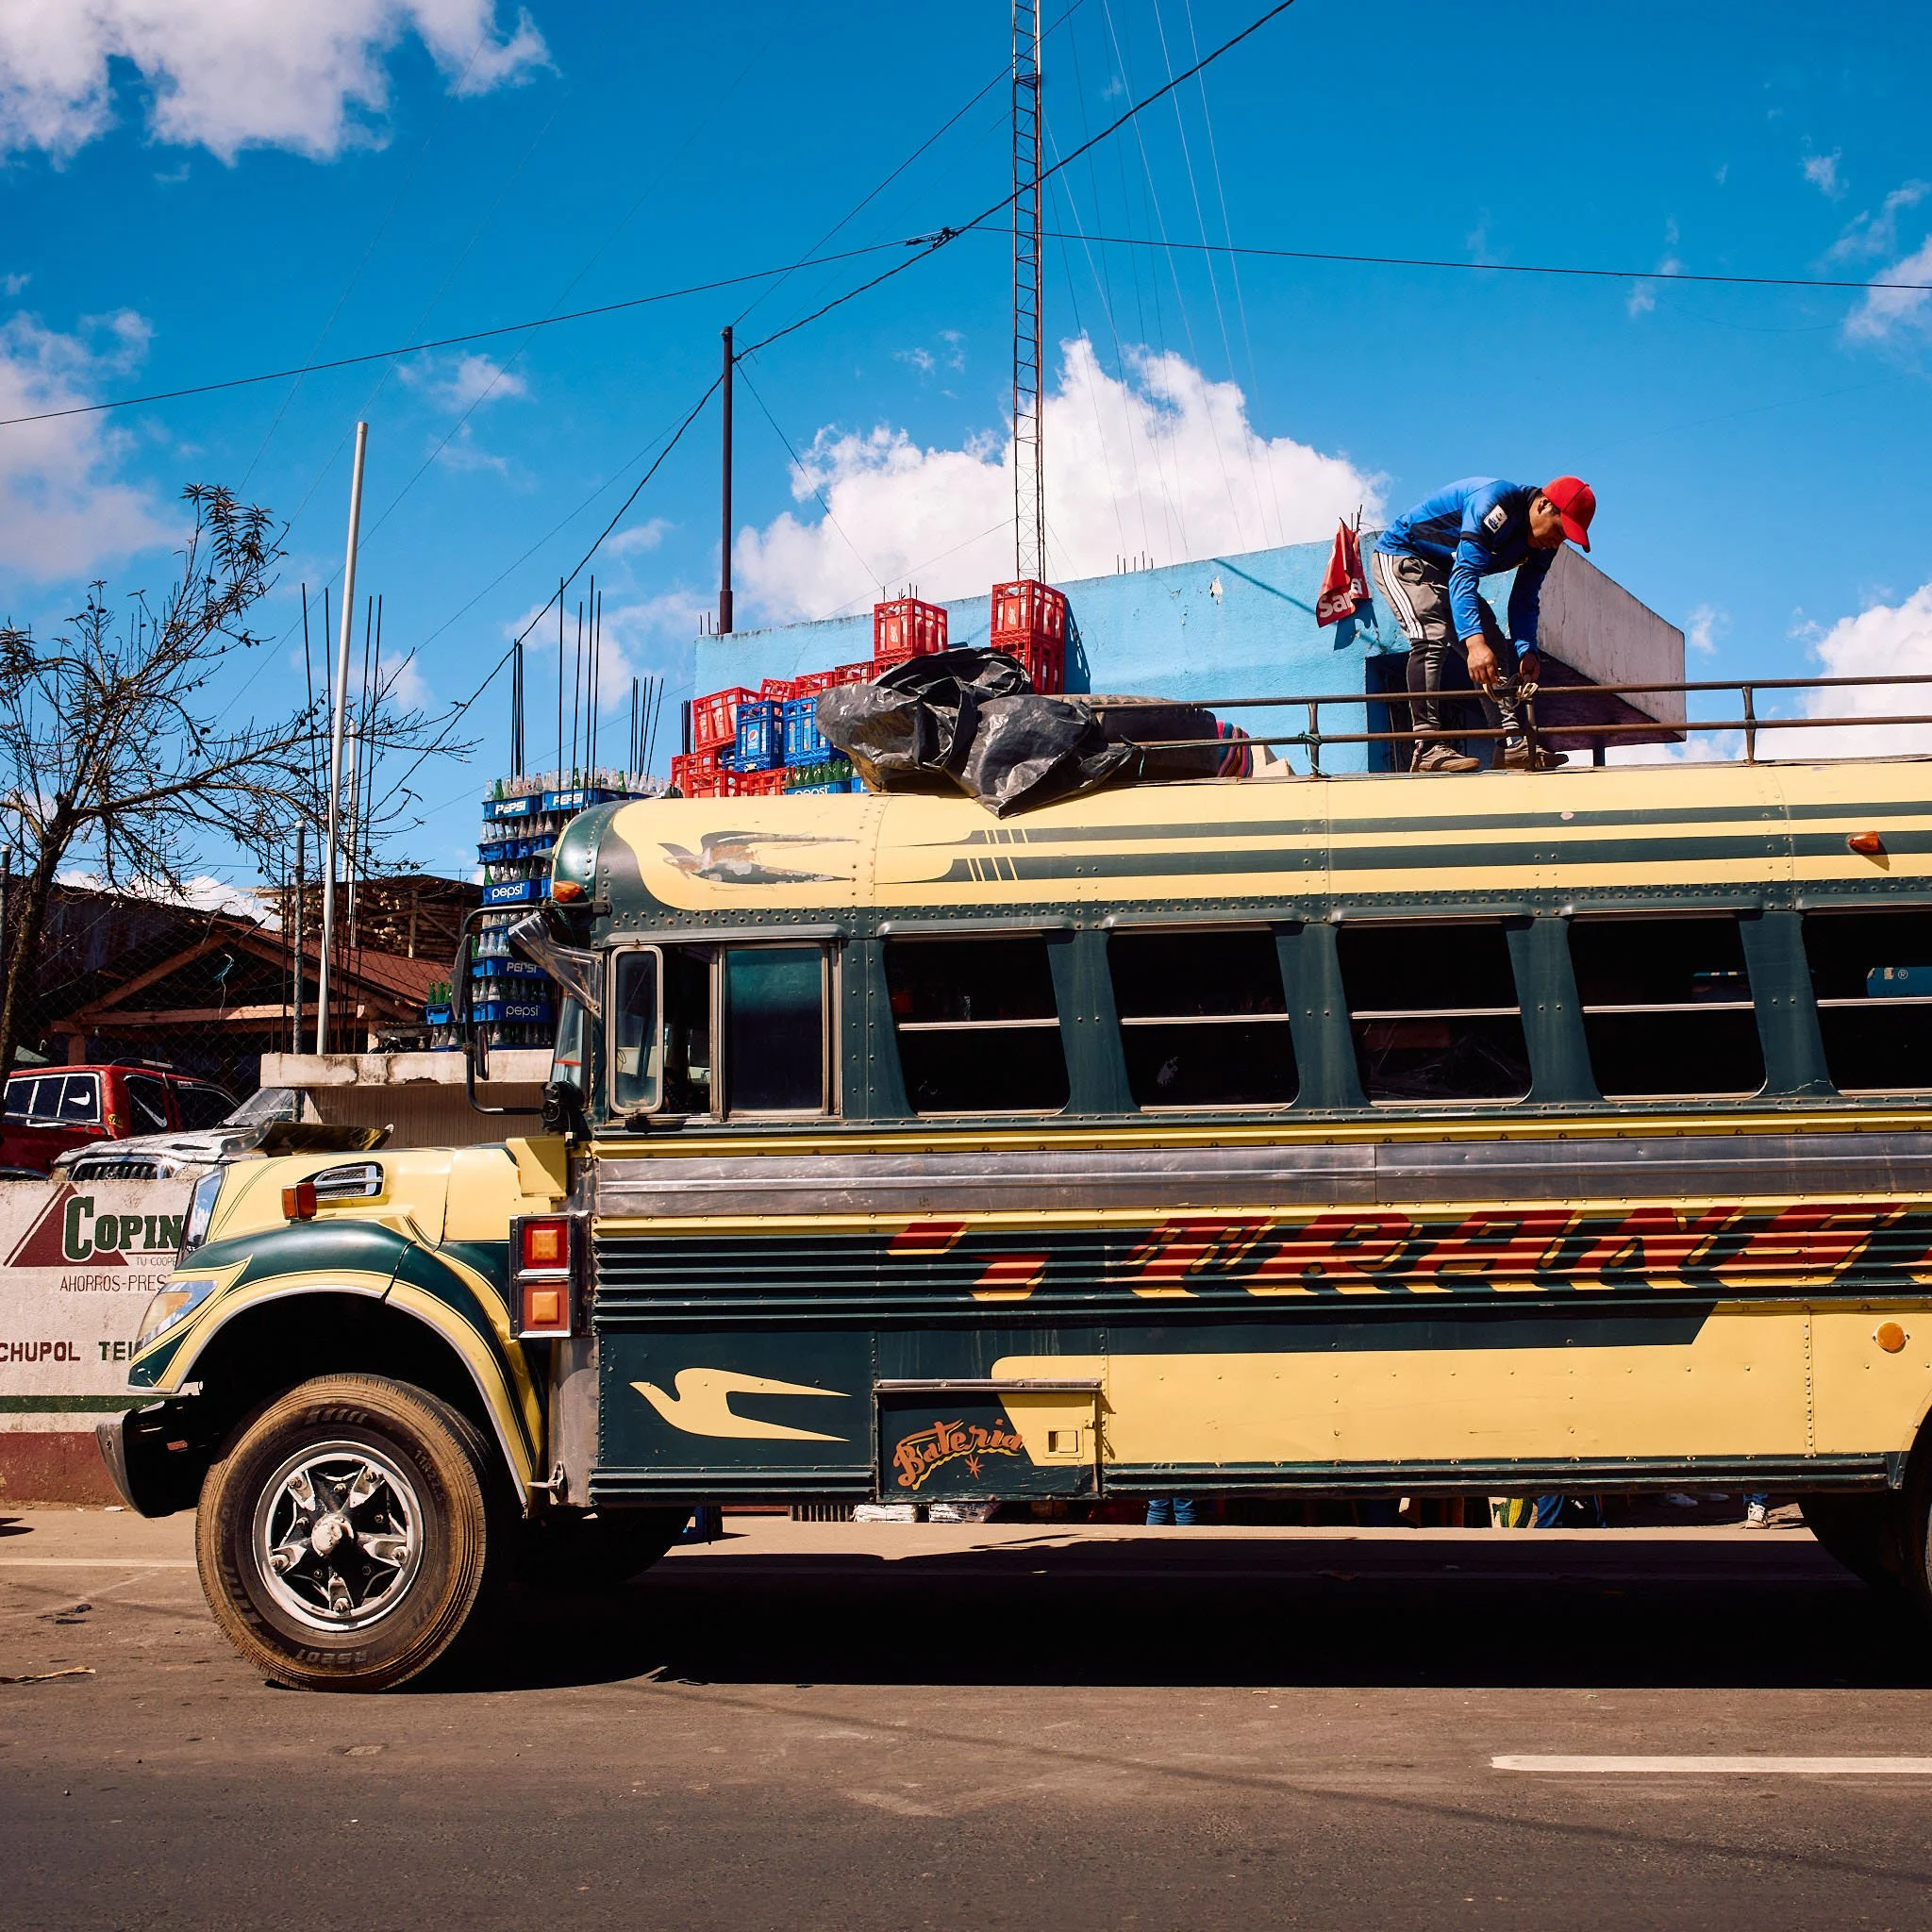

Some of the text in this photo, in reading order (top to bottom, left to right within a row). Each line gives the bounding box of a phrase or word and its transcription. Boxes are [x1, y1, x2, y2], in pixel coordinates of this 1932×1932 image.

[494, 800, 526, 815] PEPSI
[491, 883, 524, 900] pepsi
[506, 1006, 540, 1019] pepsi
[59, 1274, 171, 1292] AHORROS-PRES
[0, 1341, 81, 1361] CHUPOL
[892, 1418, 1024, 1488] Bateria
